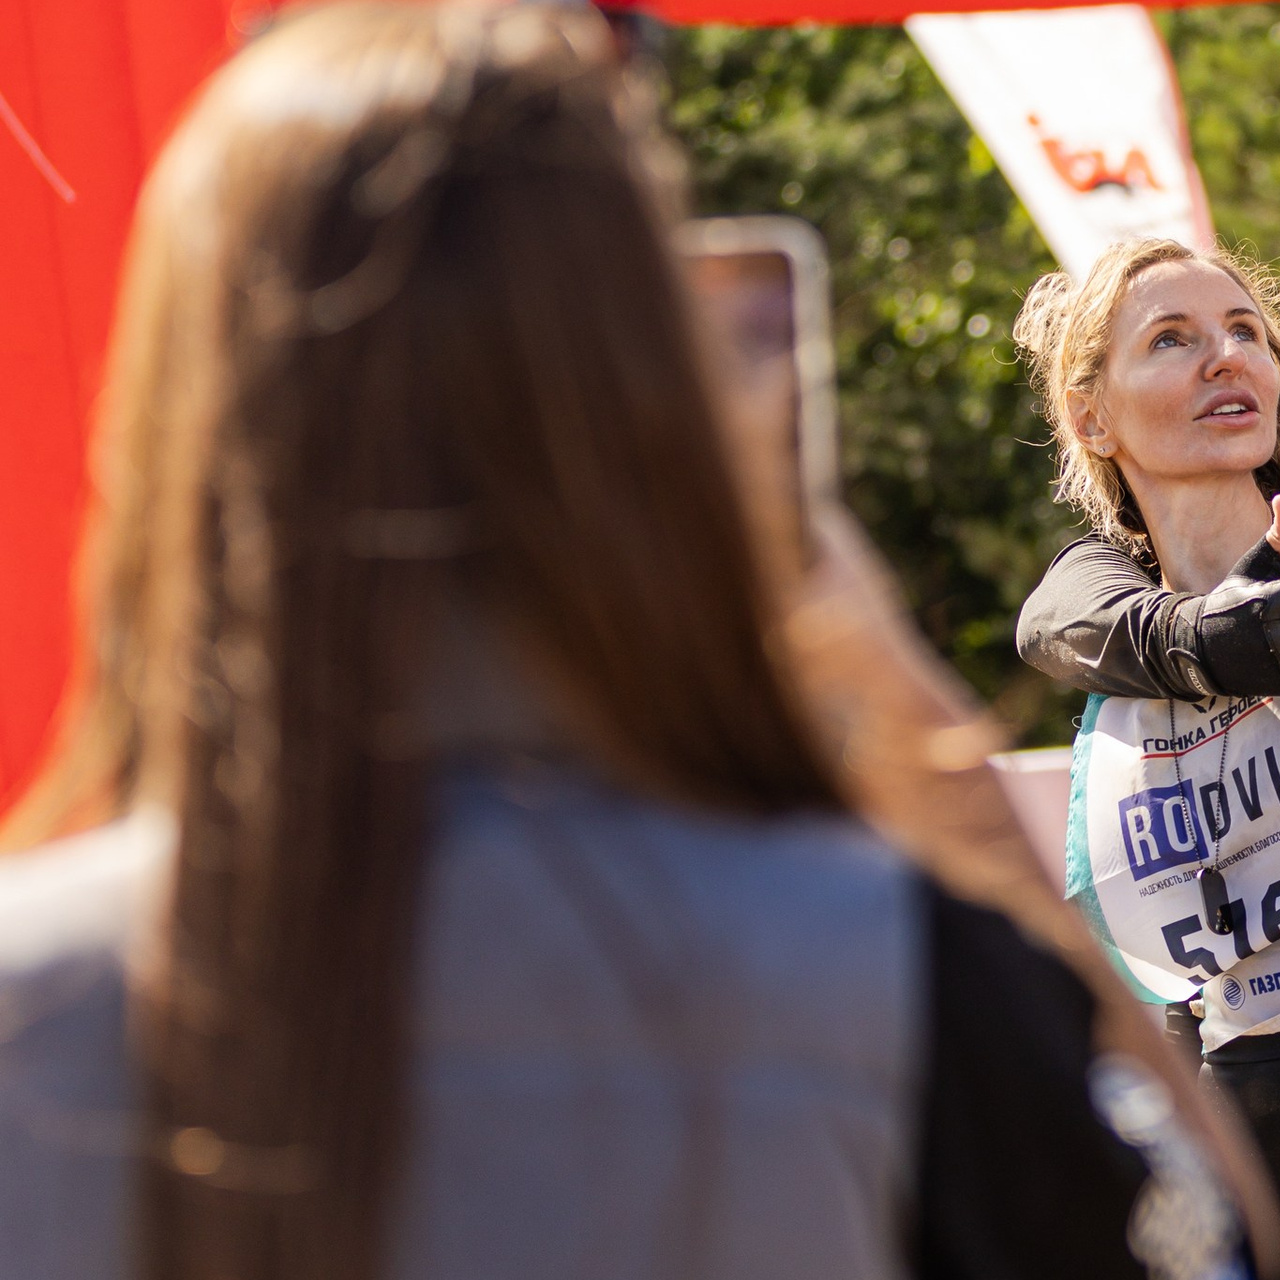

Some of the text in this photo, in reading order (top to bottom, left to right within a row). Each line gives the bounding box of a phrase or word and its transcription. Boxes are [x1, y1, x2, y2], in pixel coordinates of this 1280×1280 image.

[1143, 696, 1264, 752] ГОНКА ГЕРОЕ
[1138, 873, 1183, 898] НАДЕЖНОСТЬ
